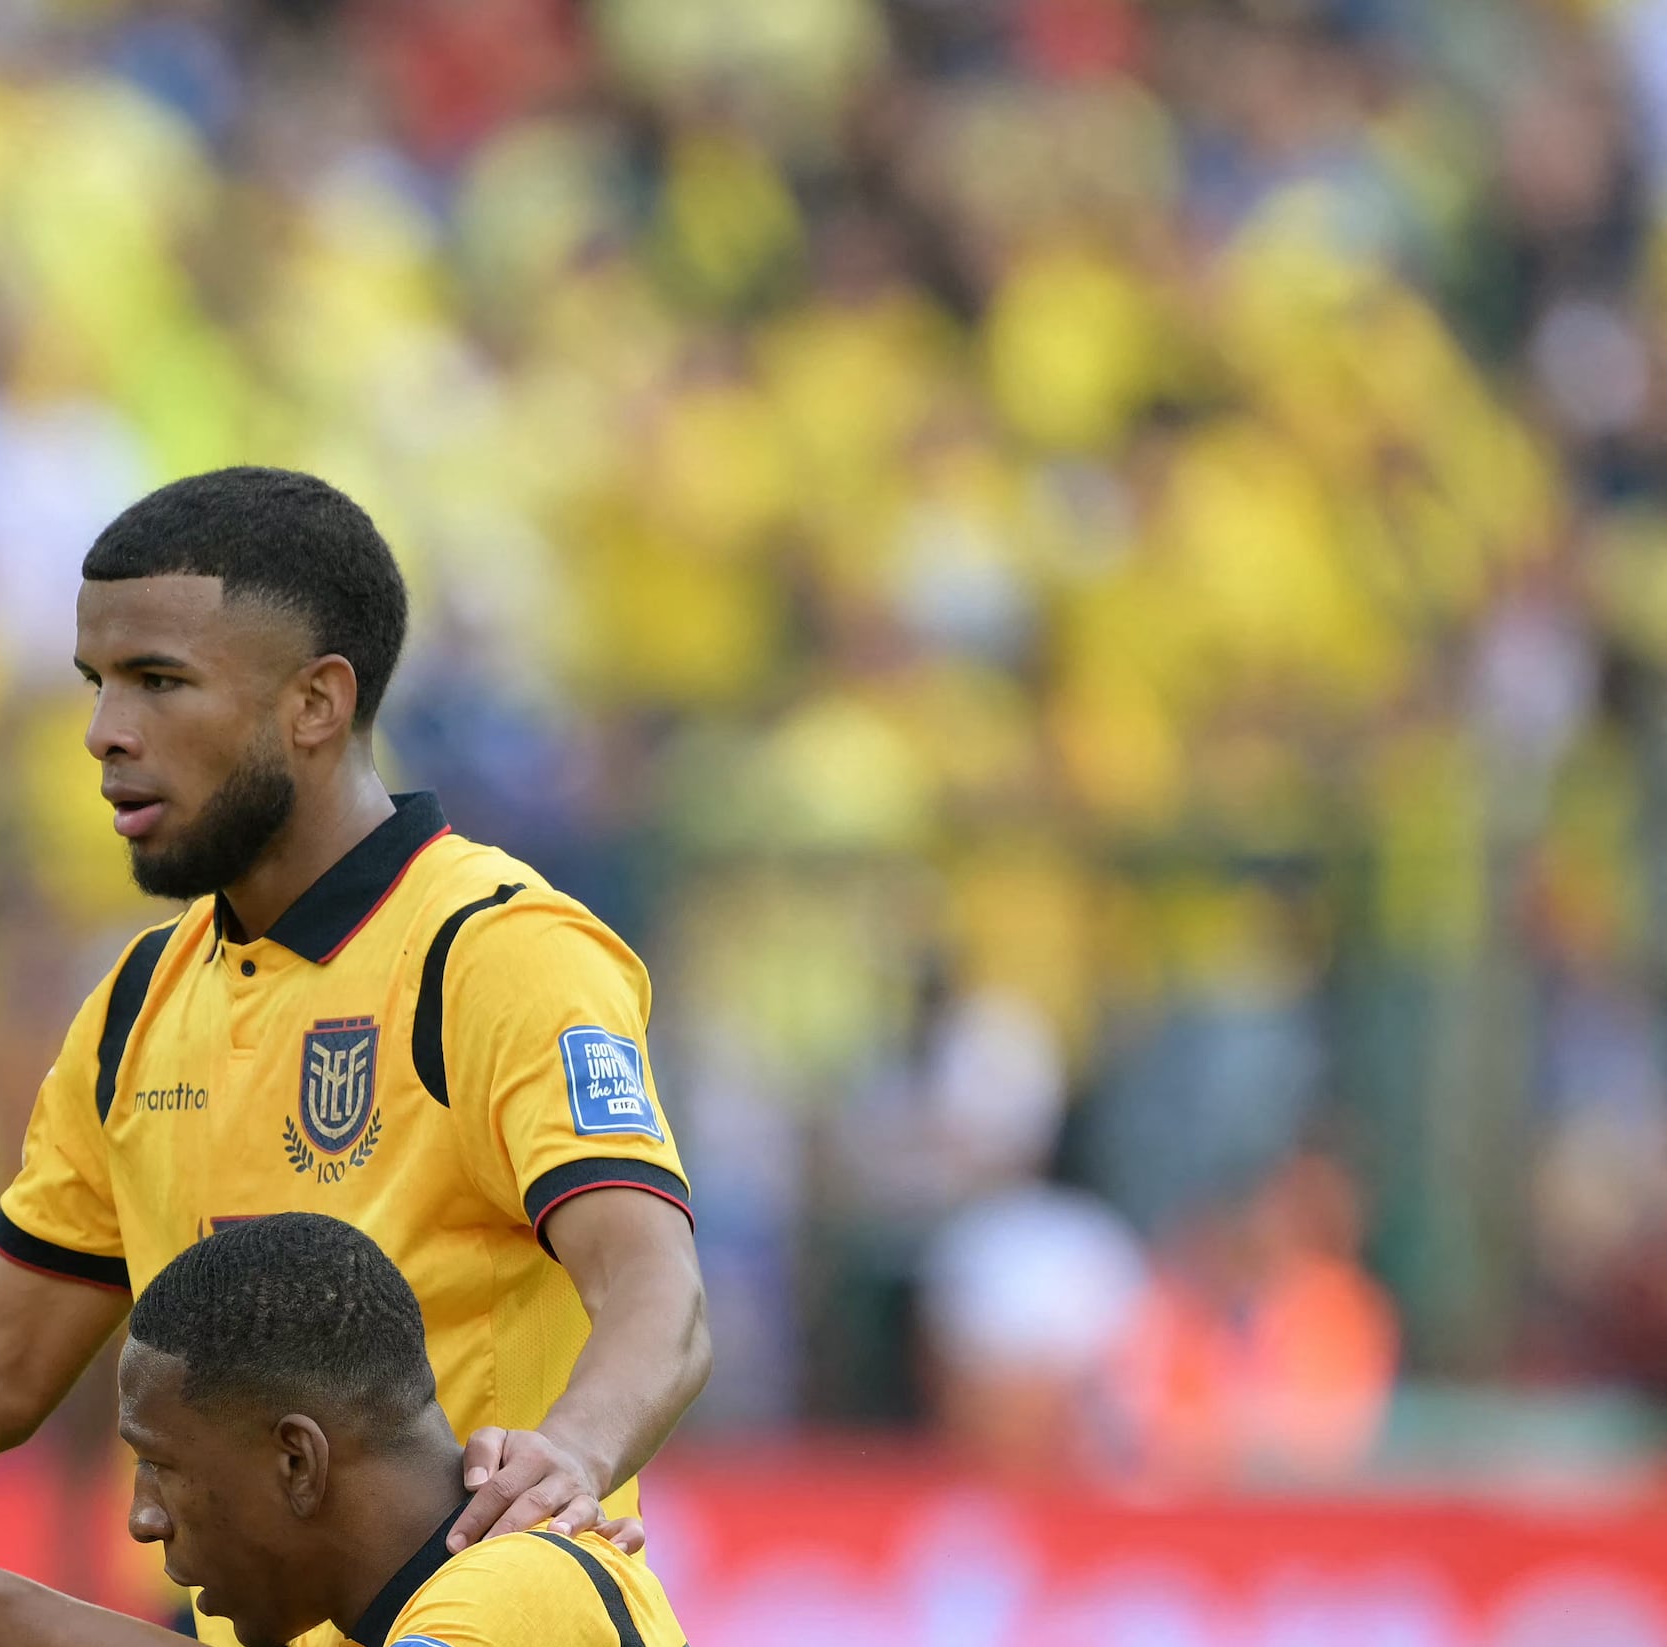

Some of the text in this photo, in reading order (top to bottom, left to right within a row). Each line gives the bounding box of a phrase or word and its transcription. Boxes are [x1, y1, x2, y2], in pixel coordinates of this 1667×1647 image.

[134, 1082, 208, 1112] maratho
[613, 1101, 637, 1110] FIFA
[317, 1161, 345, 1184] 100
